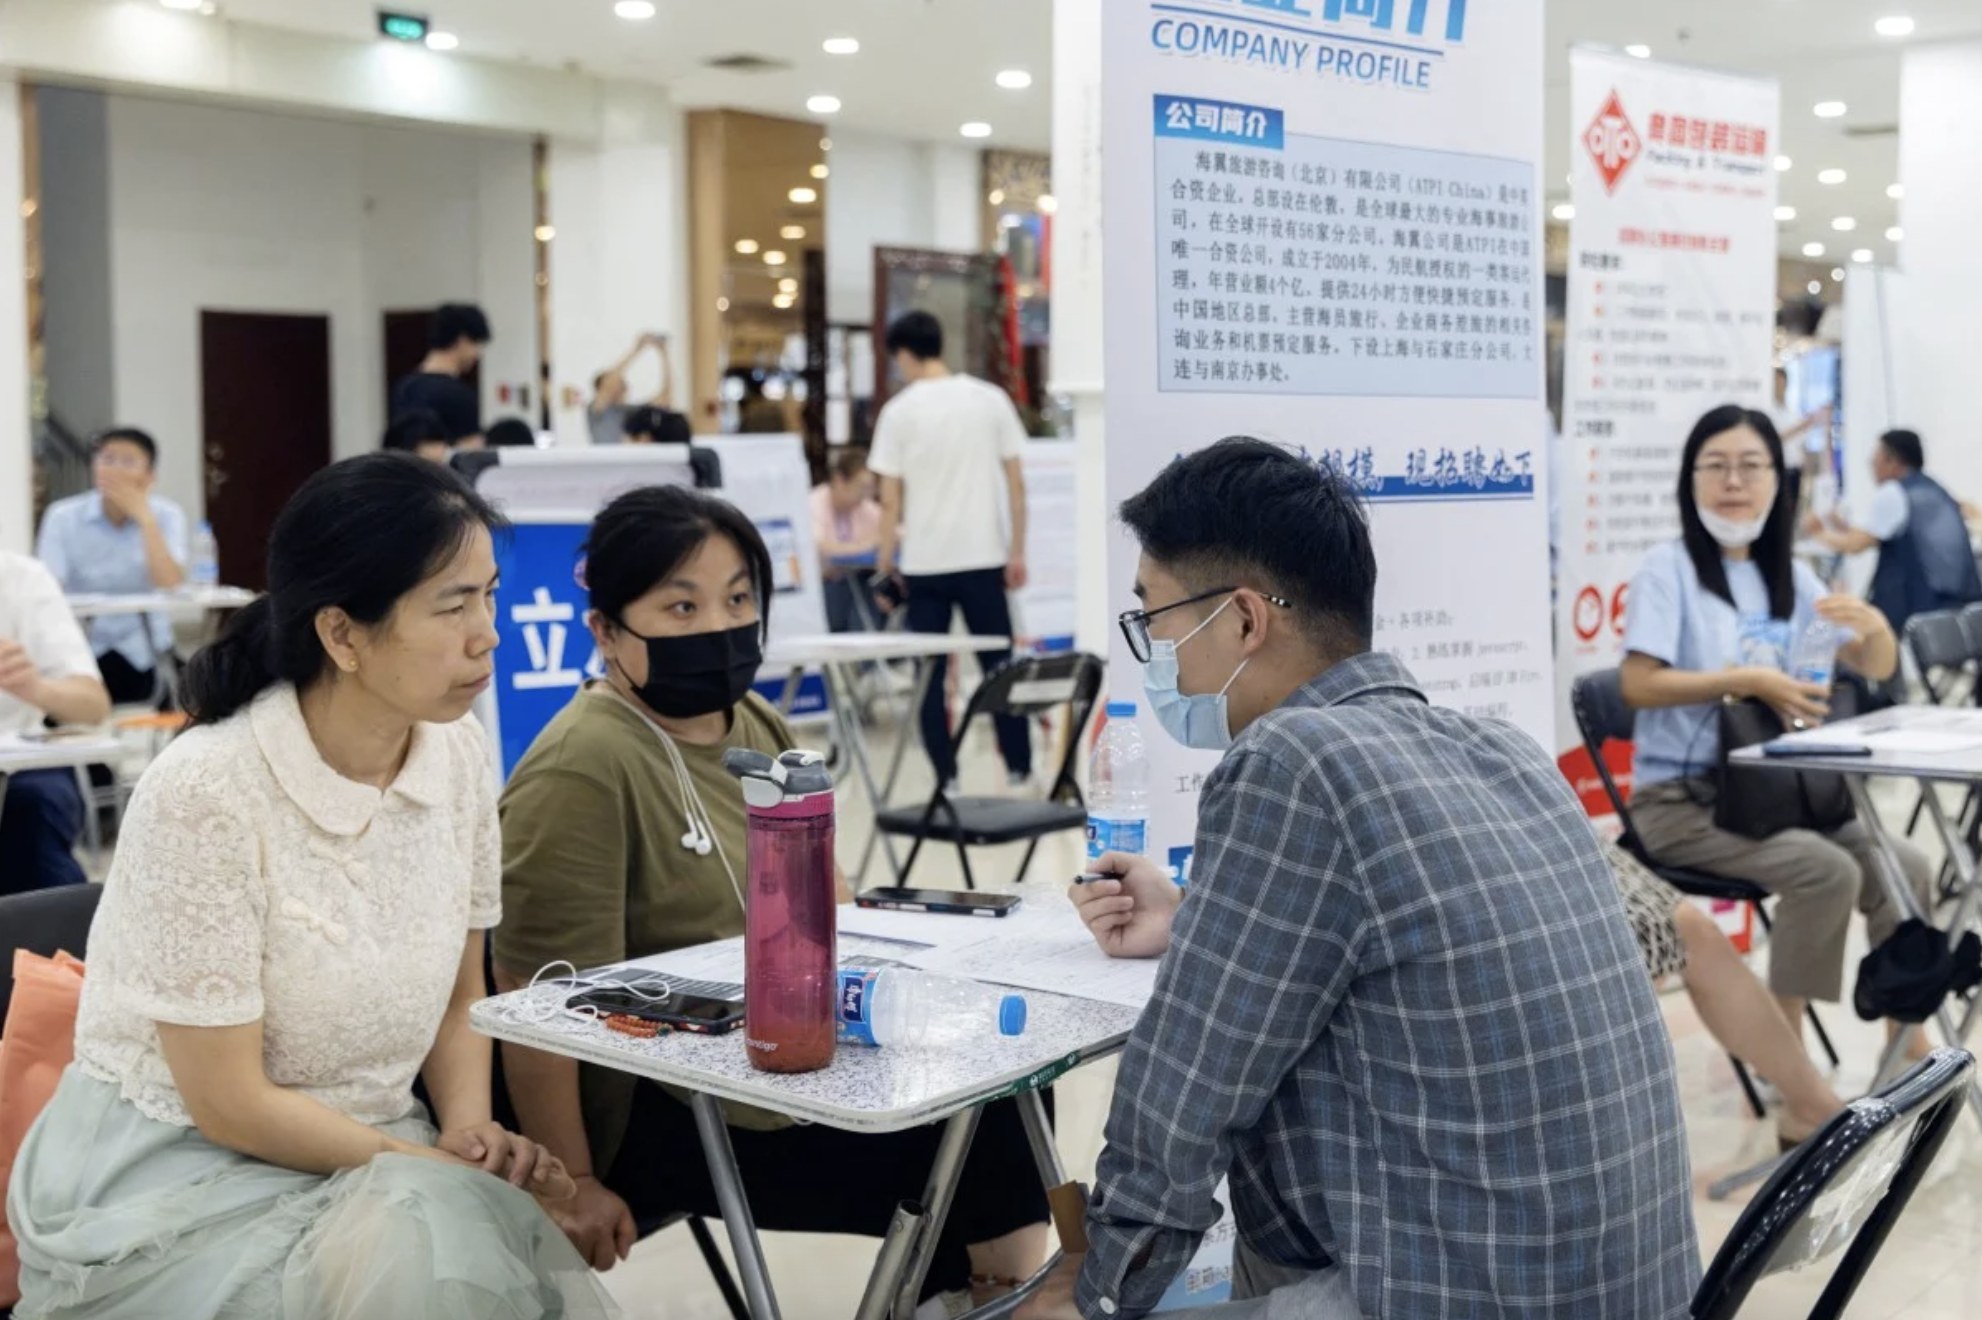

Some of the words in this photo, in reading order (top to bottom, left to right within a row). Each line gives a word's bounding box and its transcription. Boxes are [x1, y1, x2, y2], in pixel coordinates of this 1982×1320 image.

[1151, 19, 1308, 69] COMPANY
[1317, 45, 1431, 88] PROFILE
[1165, 101, 1267, 139] 公司简介
[511, 586, 607, 690] 立
